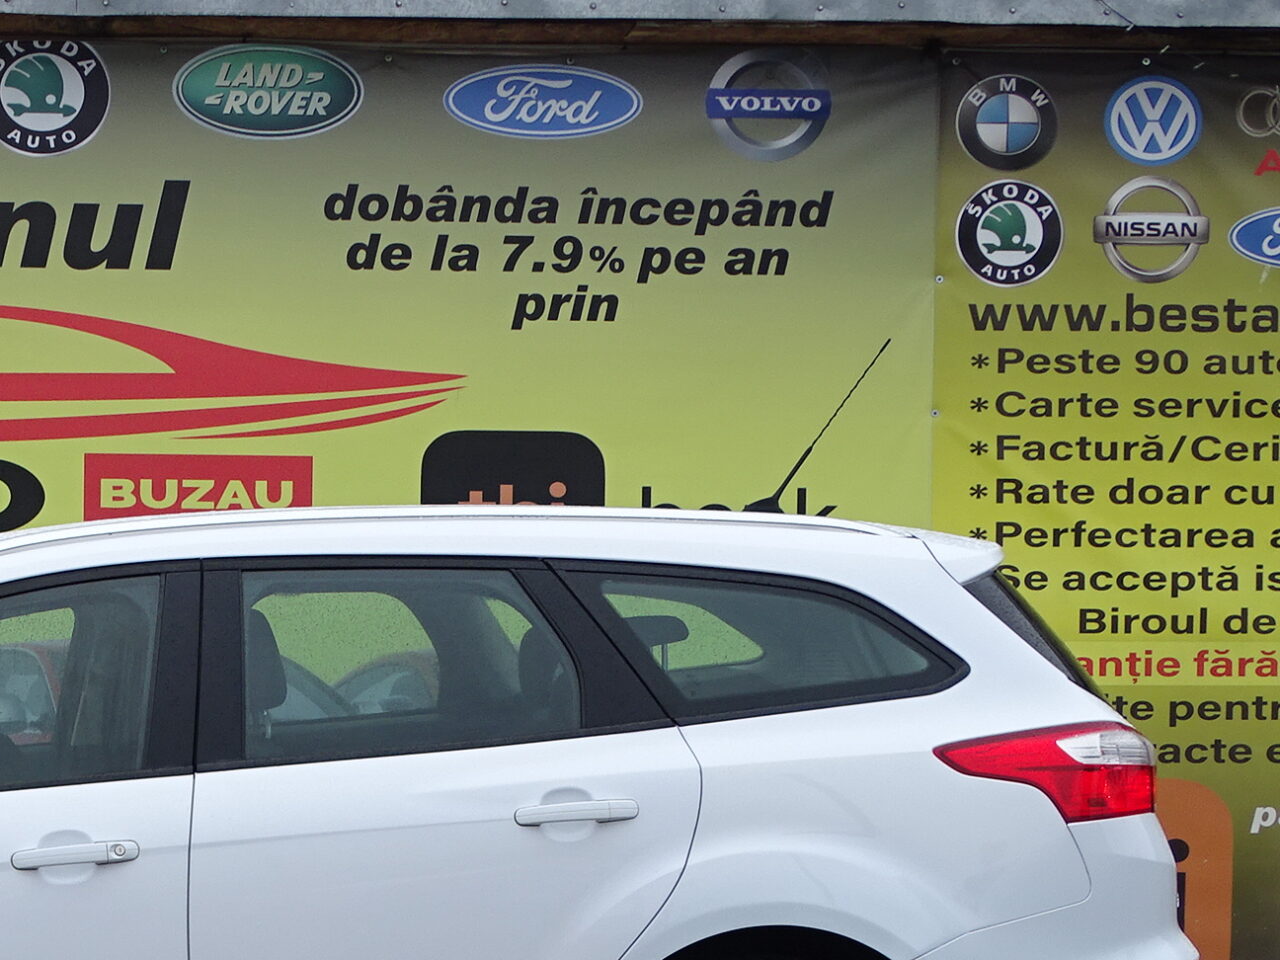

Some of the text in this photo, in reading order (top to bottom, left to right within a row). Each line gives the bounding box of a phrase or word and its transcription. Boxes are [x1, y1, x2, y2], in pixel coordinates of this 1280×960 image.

[214, 61, 302, 89] LAND
[224, 90, 332, 118] ROVER
[483, 74, 601, 126] Ford
[714, 95, 822, 114] VOLVO
[969, 77, 1049, 108] BMW
[6, 128, 77, 149] AUTO
[323, 183, 834, 236] dobânda începând
[1104, 221, 1198, 238] NISSAN
[346, 233, 790, 284] de la 7.9% pe an
[980, 263, 1036, 281] AUTO
[510, 284, 619, 330] prin
[968, 293, 1279, 334] www.besta
[1134, 349, 1189, 375] 90
[1203, 350, 1280, 375] aut
[100, 478, 294, 509] BUZAU
[1108, 477, 1211, 505] doar
[1224, 484, 1275, 506] cu
[996, 564, 1049, 591] Se
[1062, 565, 1239, 599] acceptă
[1078, 607, 1277, 635] Biroul de
[1193, 649, 1279, 677] fără
[1153, 739, 1253, 764] acte
